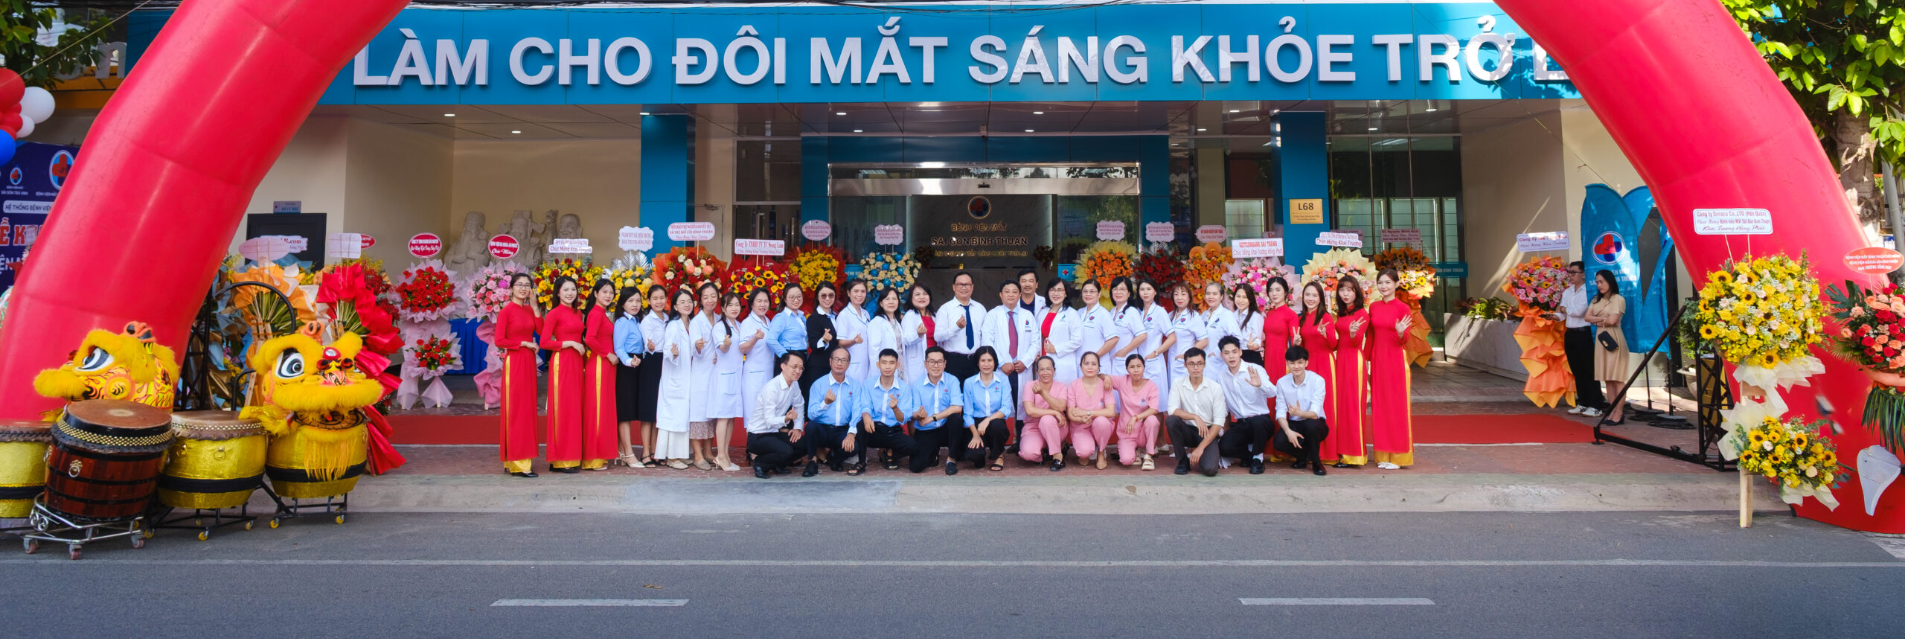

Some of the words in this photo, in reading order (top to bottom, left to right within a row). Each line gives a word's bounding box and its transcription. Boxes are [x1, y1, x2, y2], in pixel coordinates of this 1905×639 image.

[353, 28, 489, 86] LÀM
[509, 37, 653, 86] CHO
[672, 25, 786, 85] ĐÔI
[810, 17, 948, 84] MẮT
[967, 25, 1147, 85] SÁNG
[1171, 16, 1356, 84] KHỎE
[1372, 15, 1516, 83] TRỞ
[1298, 203, 1314, 211] L68
